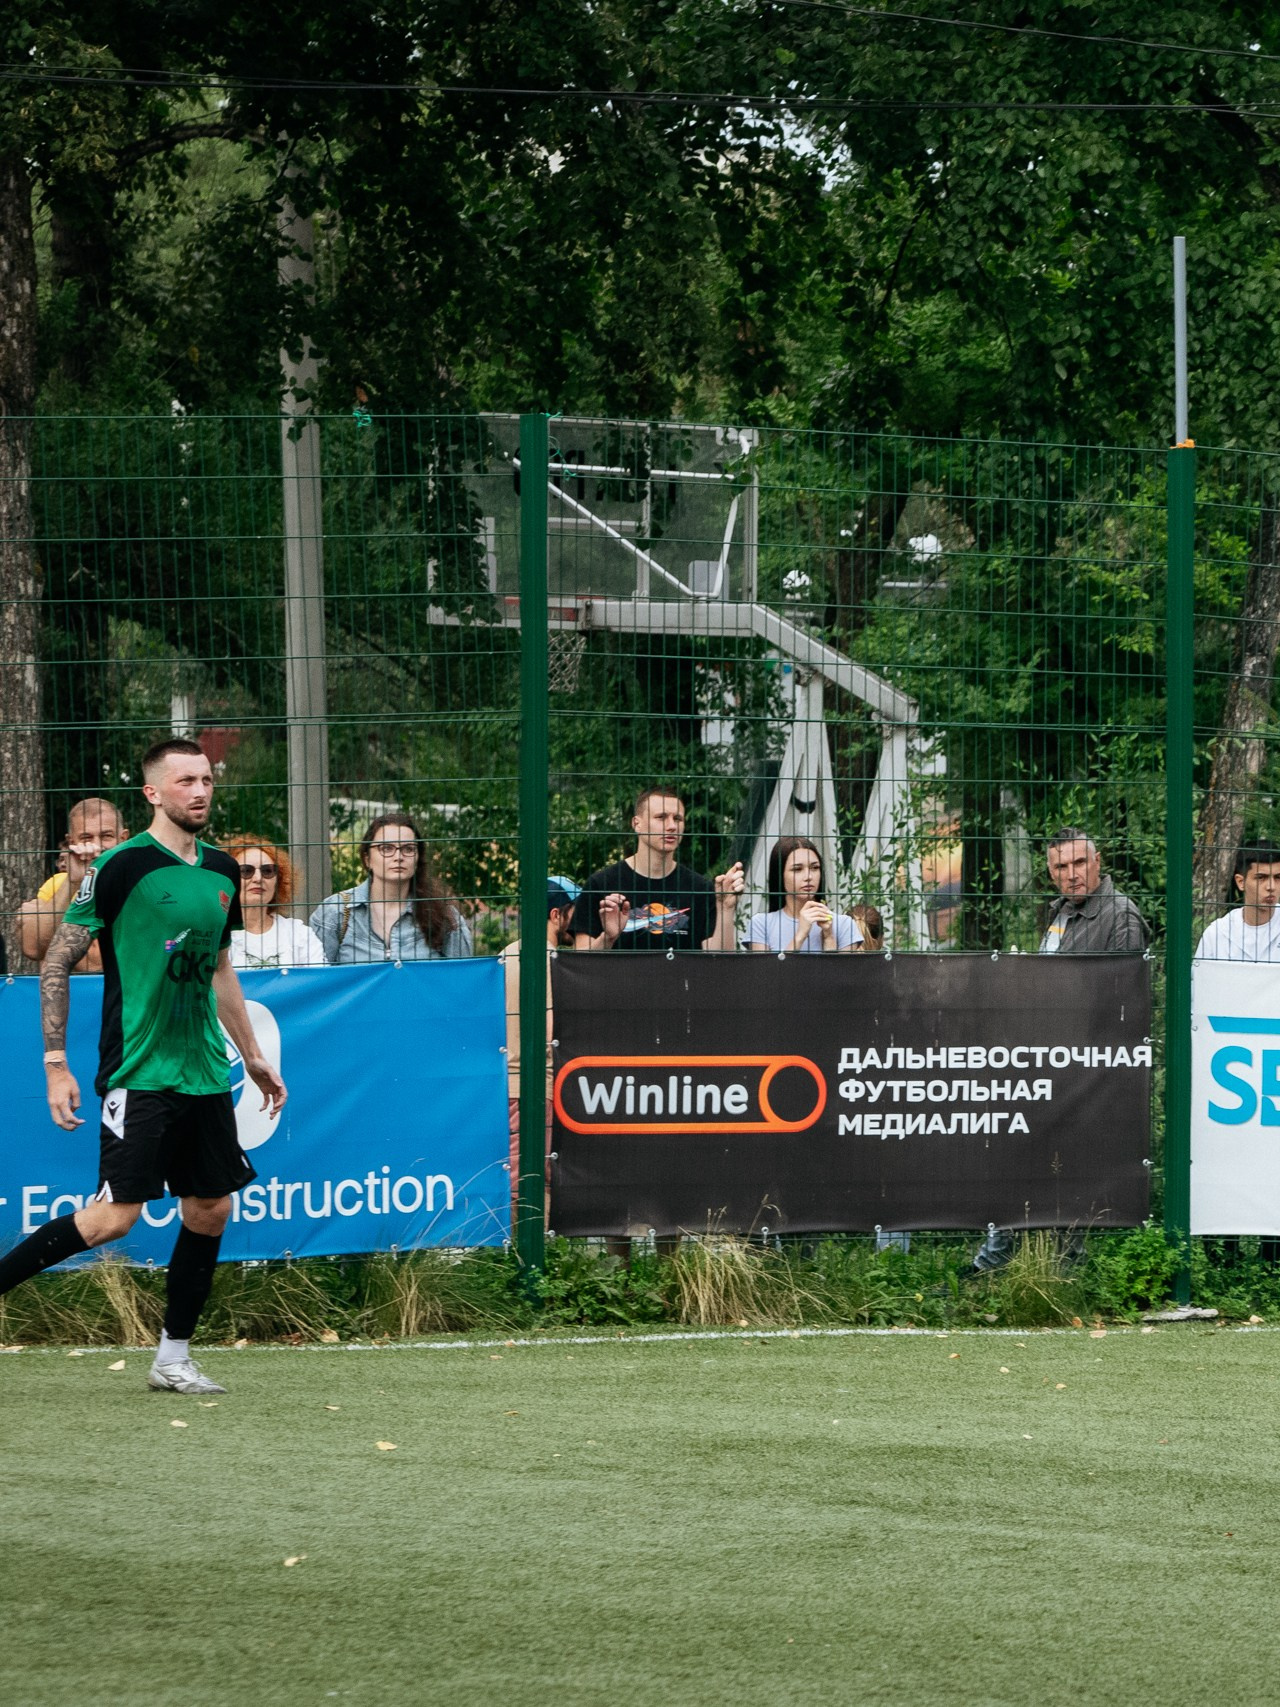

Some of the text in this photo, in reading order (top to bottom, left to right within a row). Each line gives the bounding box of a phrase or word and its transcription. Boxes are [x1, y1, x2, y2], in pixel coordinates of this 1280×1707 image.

[838, 1046, 1152, 1074] ДАЛЬНЕВОСТОЧНАЯ
[578, 1076, 749, 1115] Winline
[838, 1078, 1053, 1102] ФУТБОЛЬНАЯ
[838, 1112, 1030, 1140] МЕДИАЛИГА
